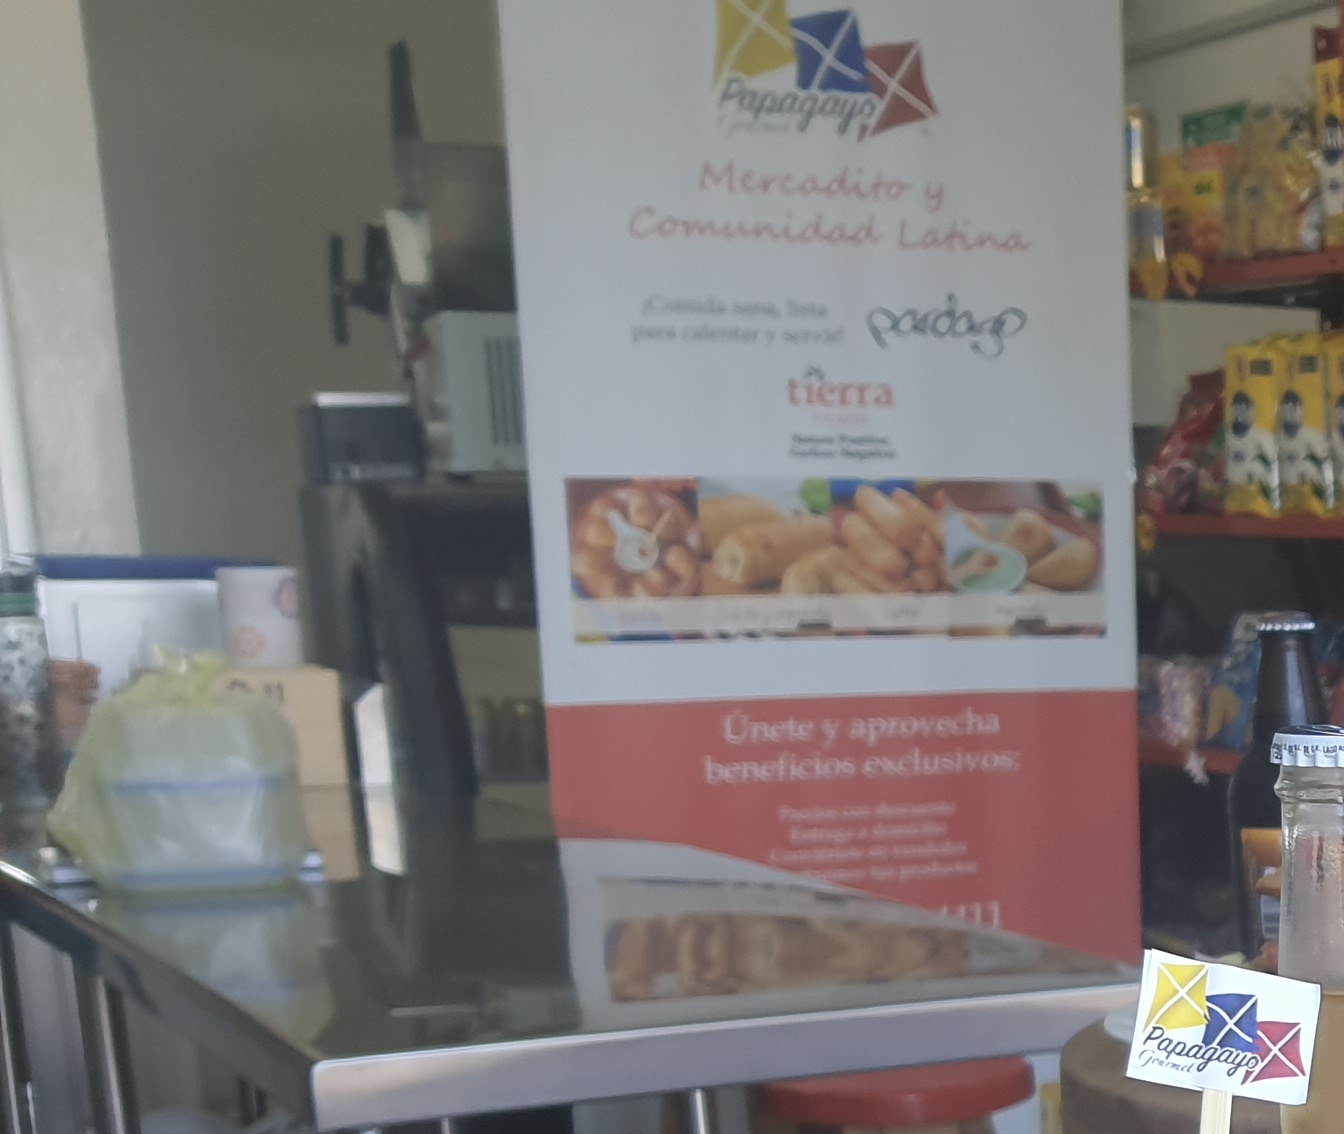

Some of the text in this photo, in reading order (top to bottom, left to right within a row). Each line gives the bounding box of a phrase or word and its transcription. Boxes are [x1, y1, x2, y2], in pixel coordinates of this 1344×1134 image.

[719, 77, 877, 134] Papagayo
[699, 161, 947, 211] Mercadito y
[628, 206, 1033, 255] Comunidad Latina
[787, 377, 894, 408] tierra
[722, 706, 1001, 747] Únete y aprovecha
[703, 745, 1021, 785] beneficios exclusivos:
[1142, 1026, 1260, 1078] Papagayo
